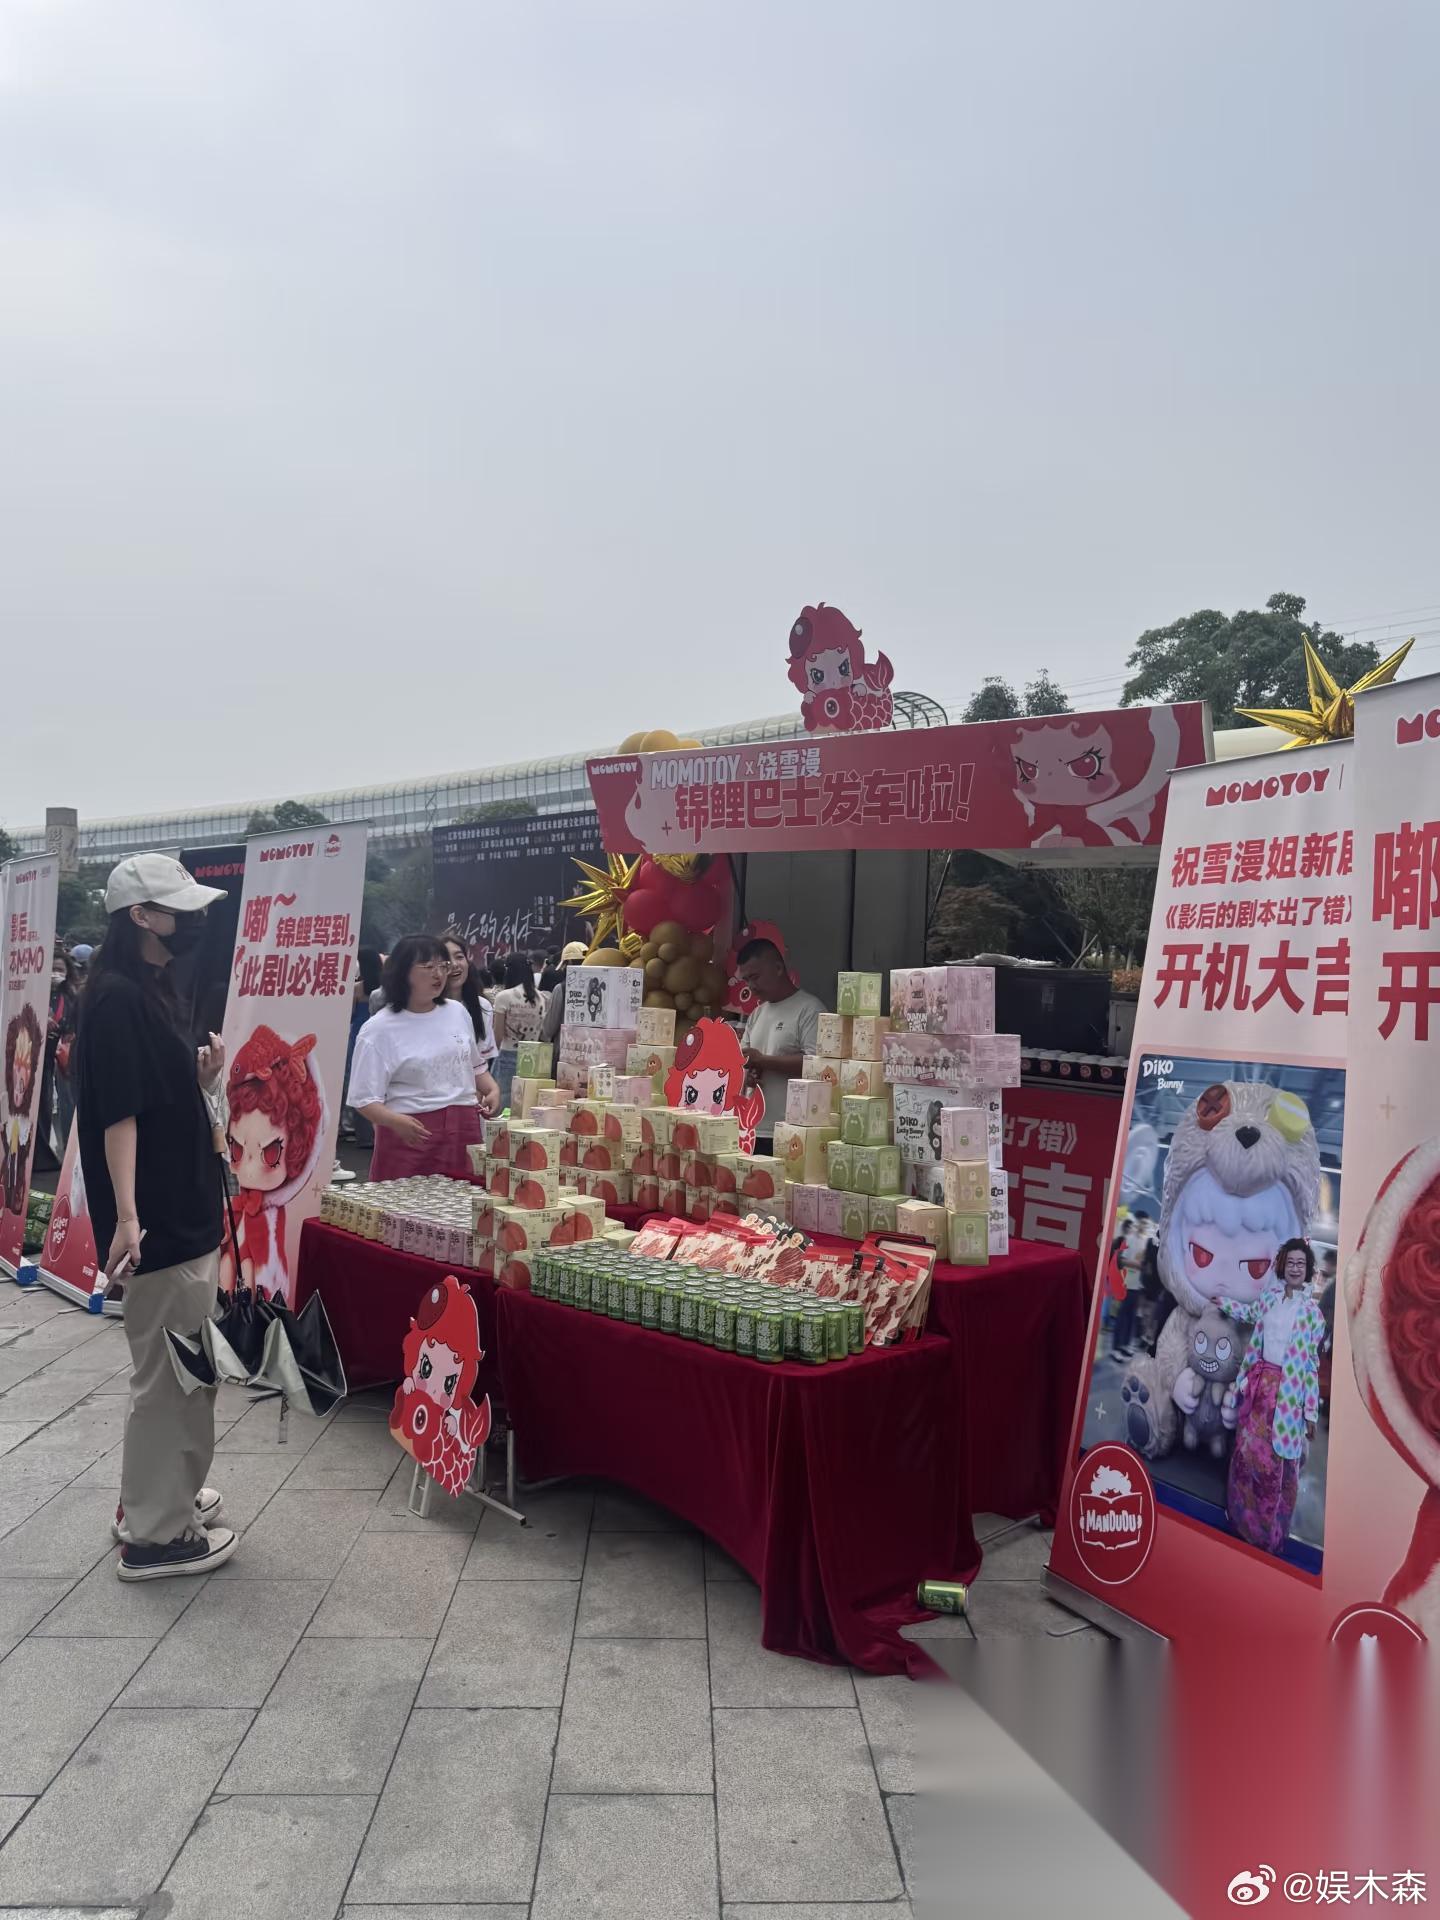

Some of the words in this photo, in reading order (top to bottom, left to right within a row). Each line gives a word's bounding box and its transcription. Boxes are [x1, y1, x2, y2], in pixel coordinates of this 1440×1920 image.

[591, 762, 637, 775] MOMOTOY
[651, 754, 741, 790] MOMOTOY
[757, 748, 822, 781] 饶雪漫
[1205, 768, 1331, 807] MOMOTOY
[674, 763, 976, 845] 锦鲤巴士发车啦!
[260, 842, 315, 863] MOMOTOY
[238, 952, 352, 998] 此剧必爆!
[1377, 951, 1440, 1041] 开
[1157, 1077, 1185, 1095] Bunny
